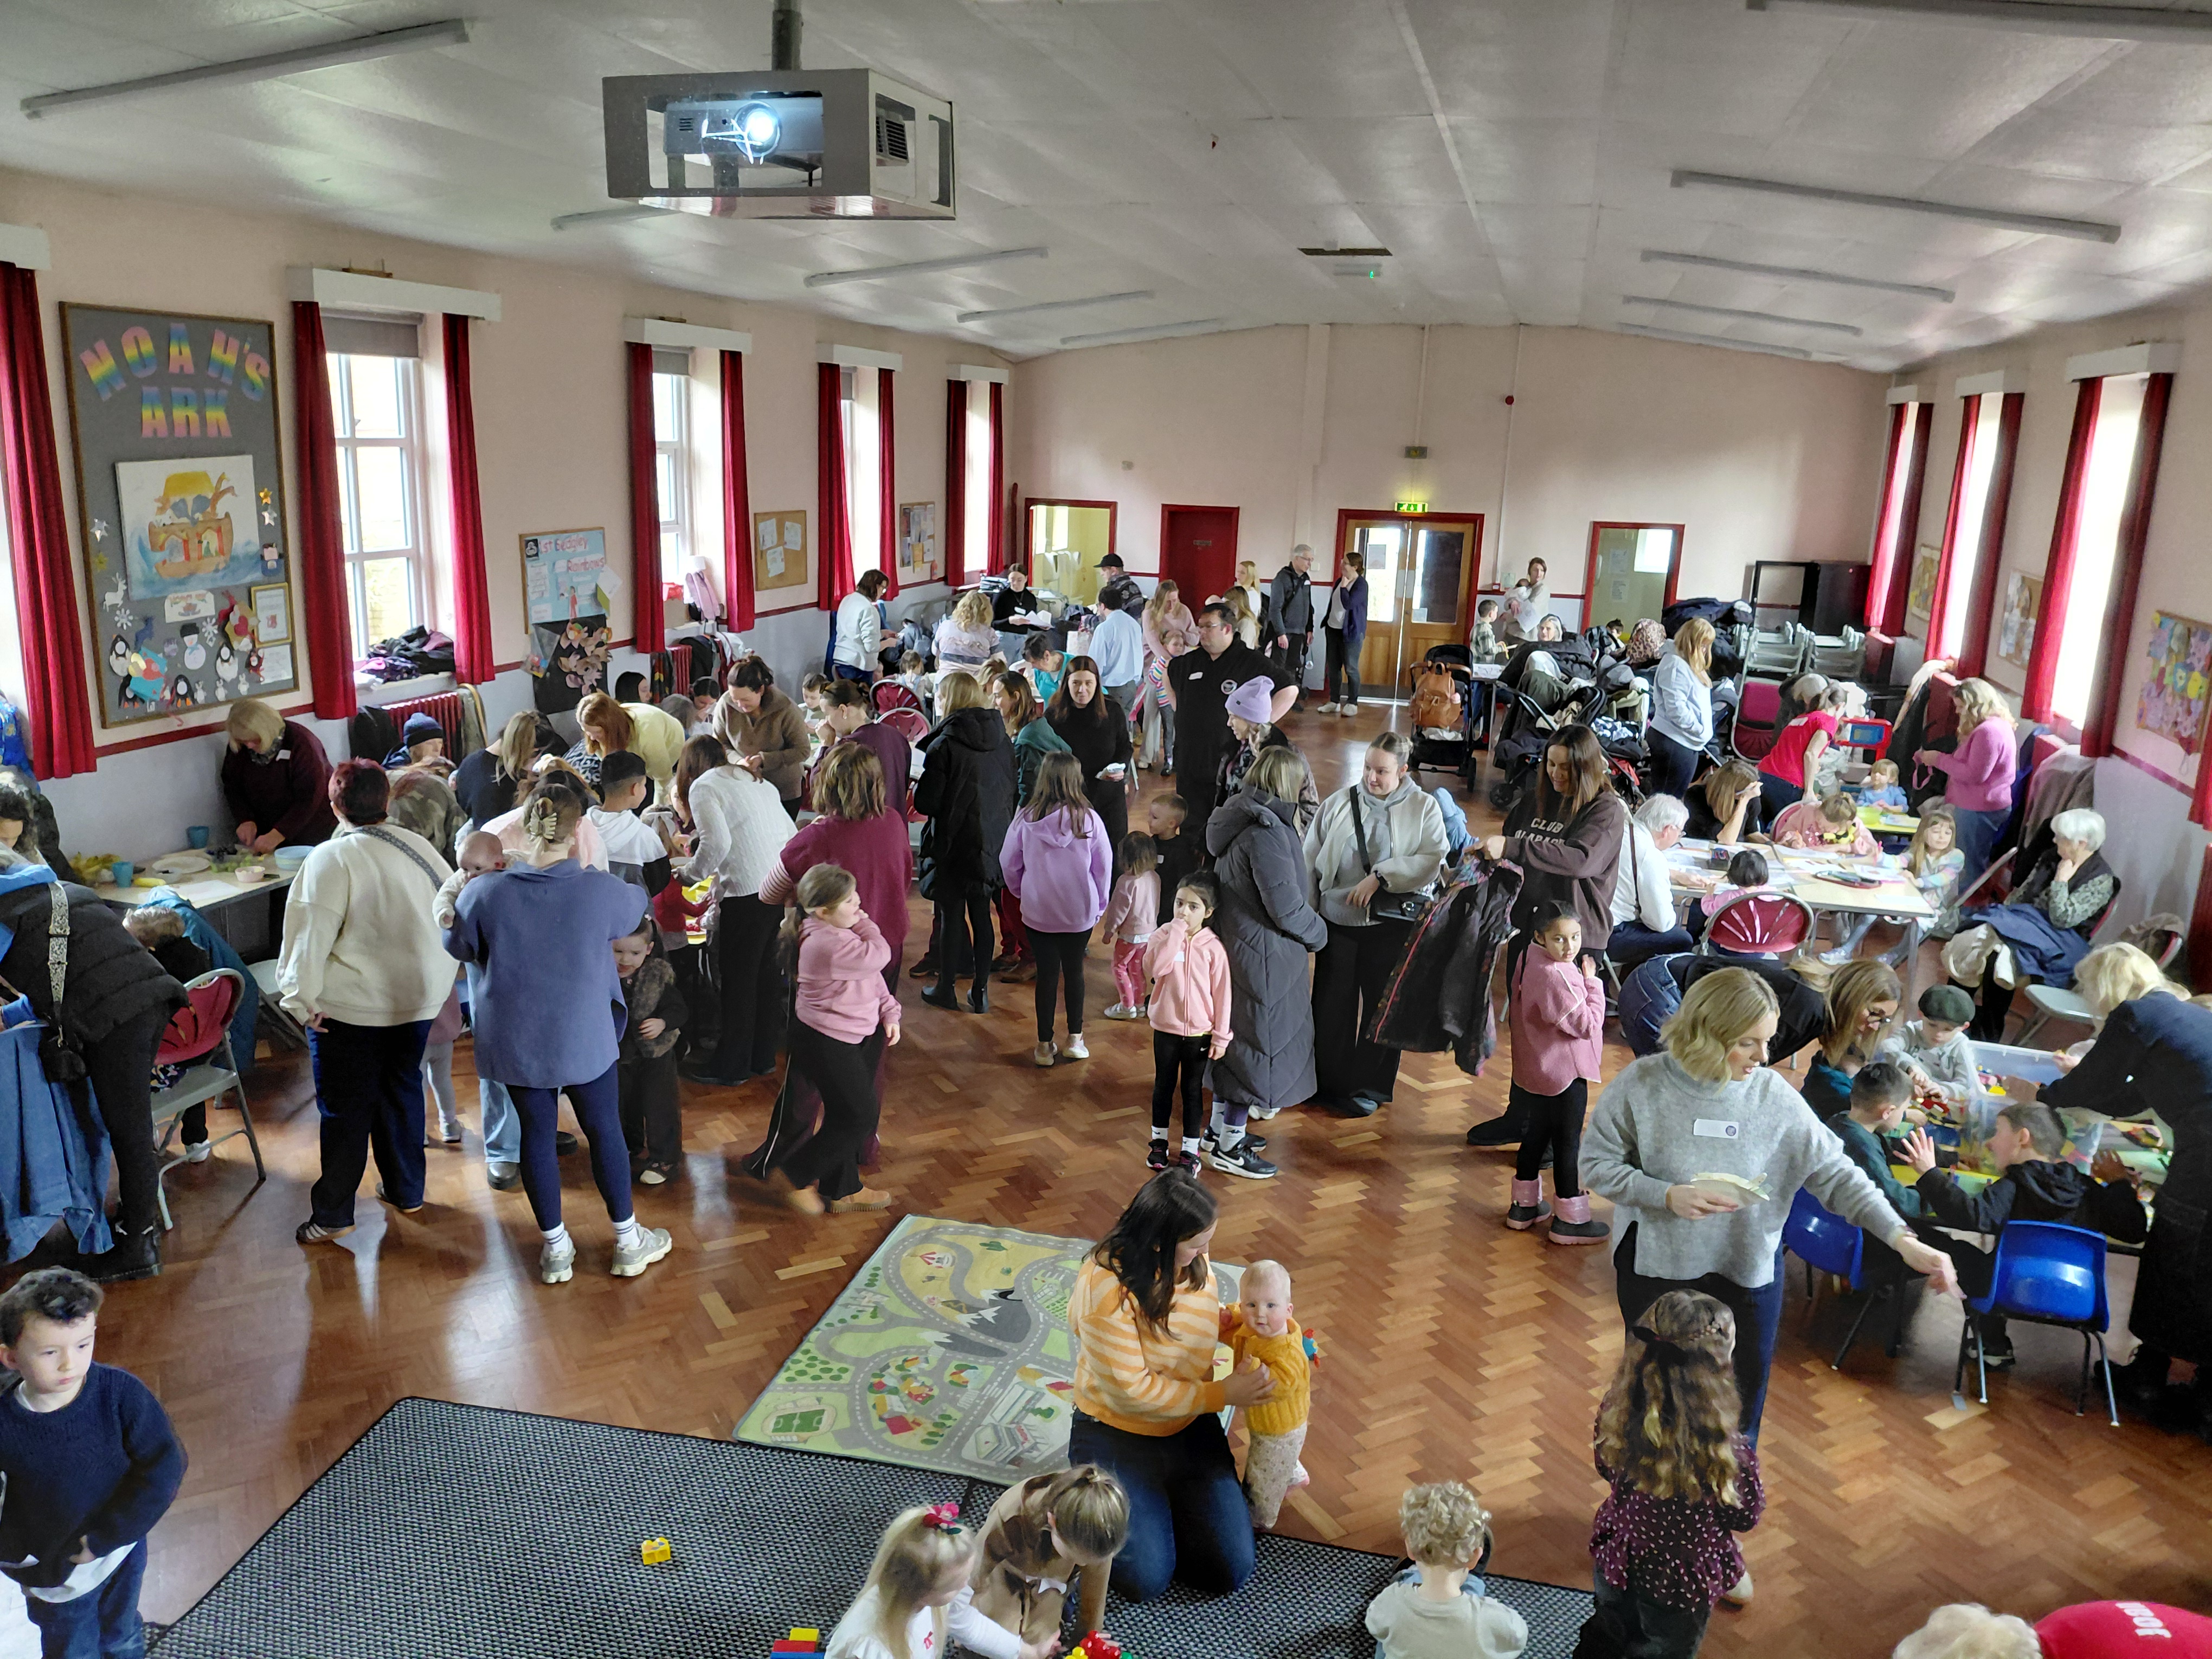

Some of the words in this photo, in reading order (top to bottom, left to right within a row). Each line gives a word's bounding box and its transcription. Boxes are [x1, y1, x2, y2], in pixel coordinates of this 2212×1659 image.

[80, 323, 270, 401] NOAH'S
[142, 385, 232, 438] ARK
[1531, 818, 1564, 833] CLUB
